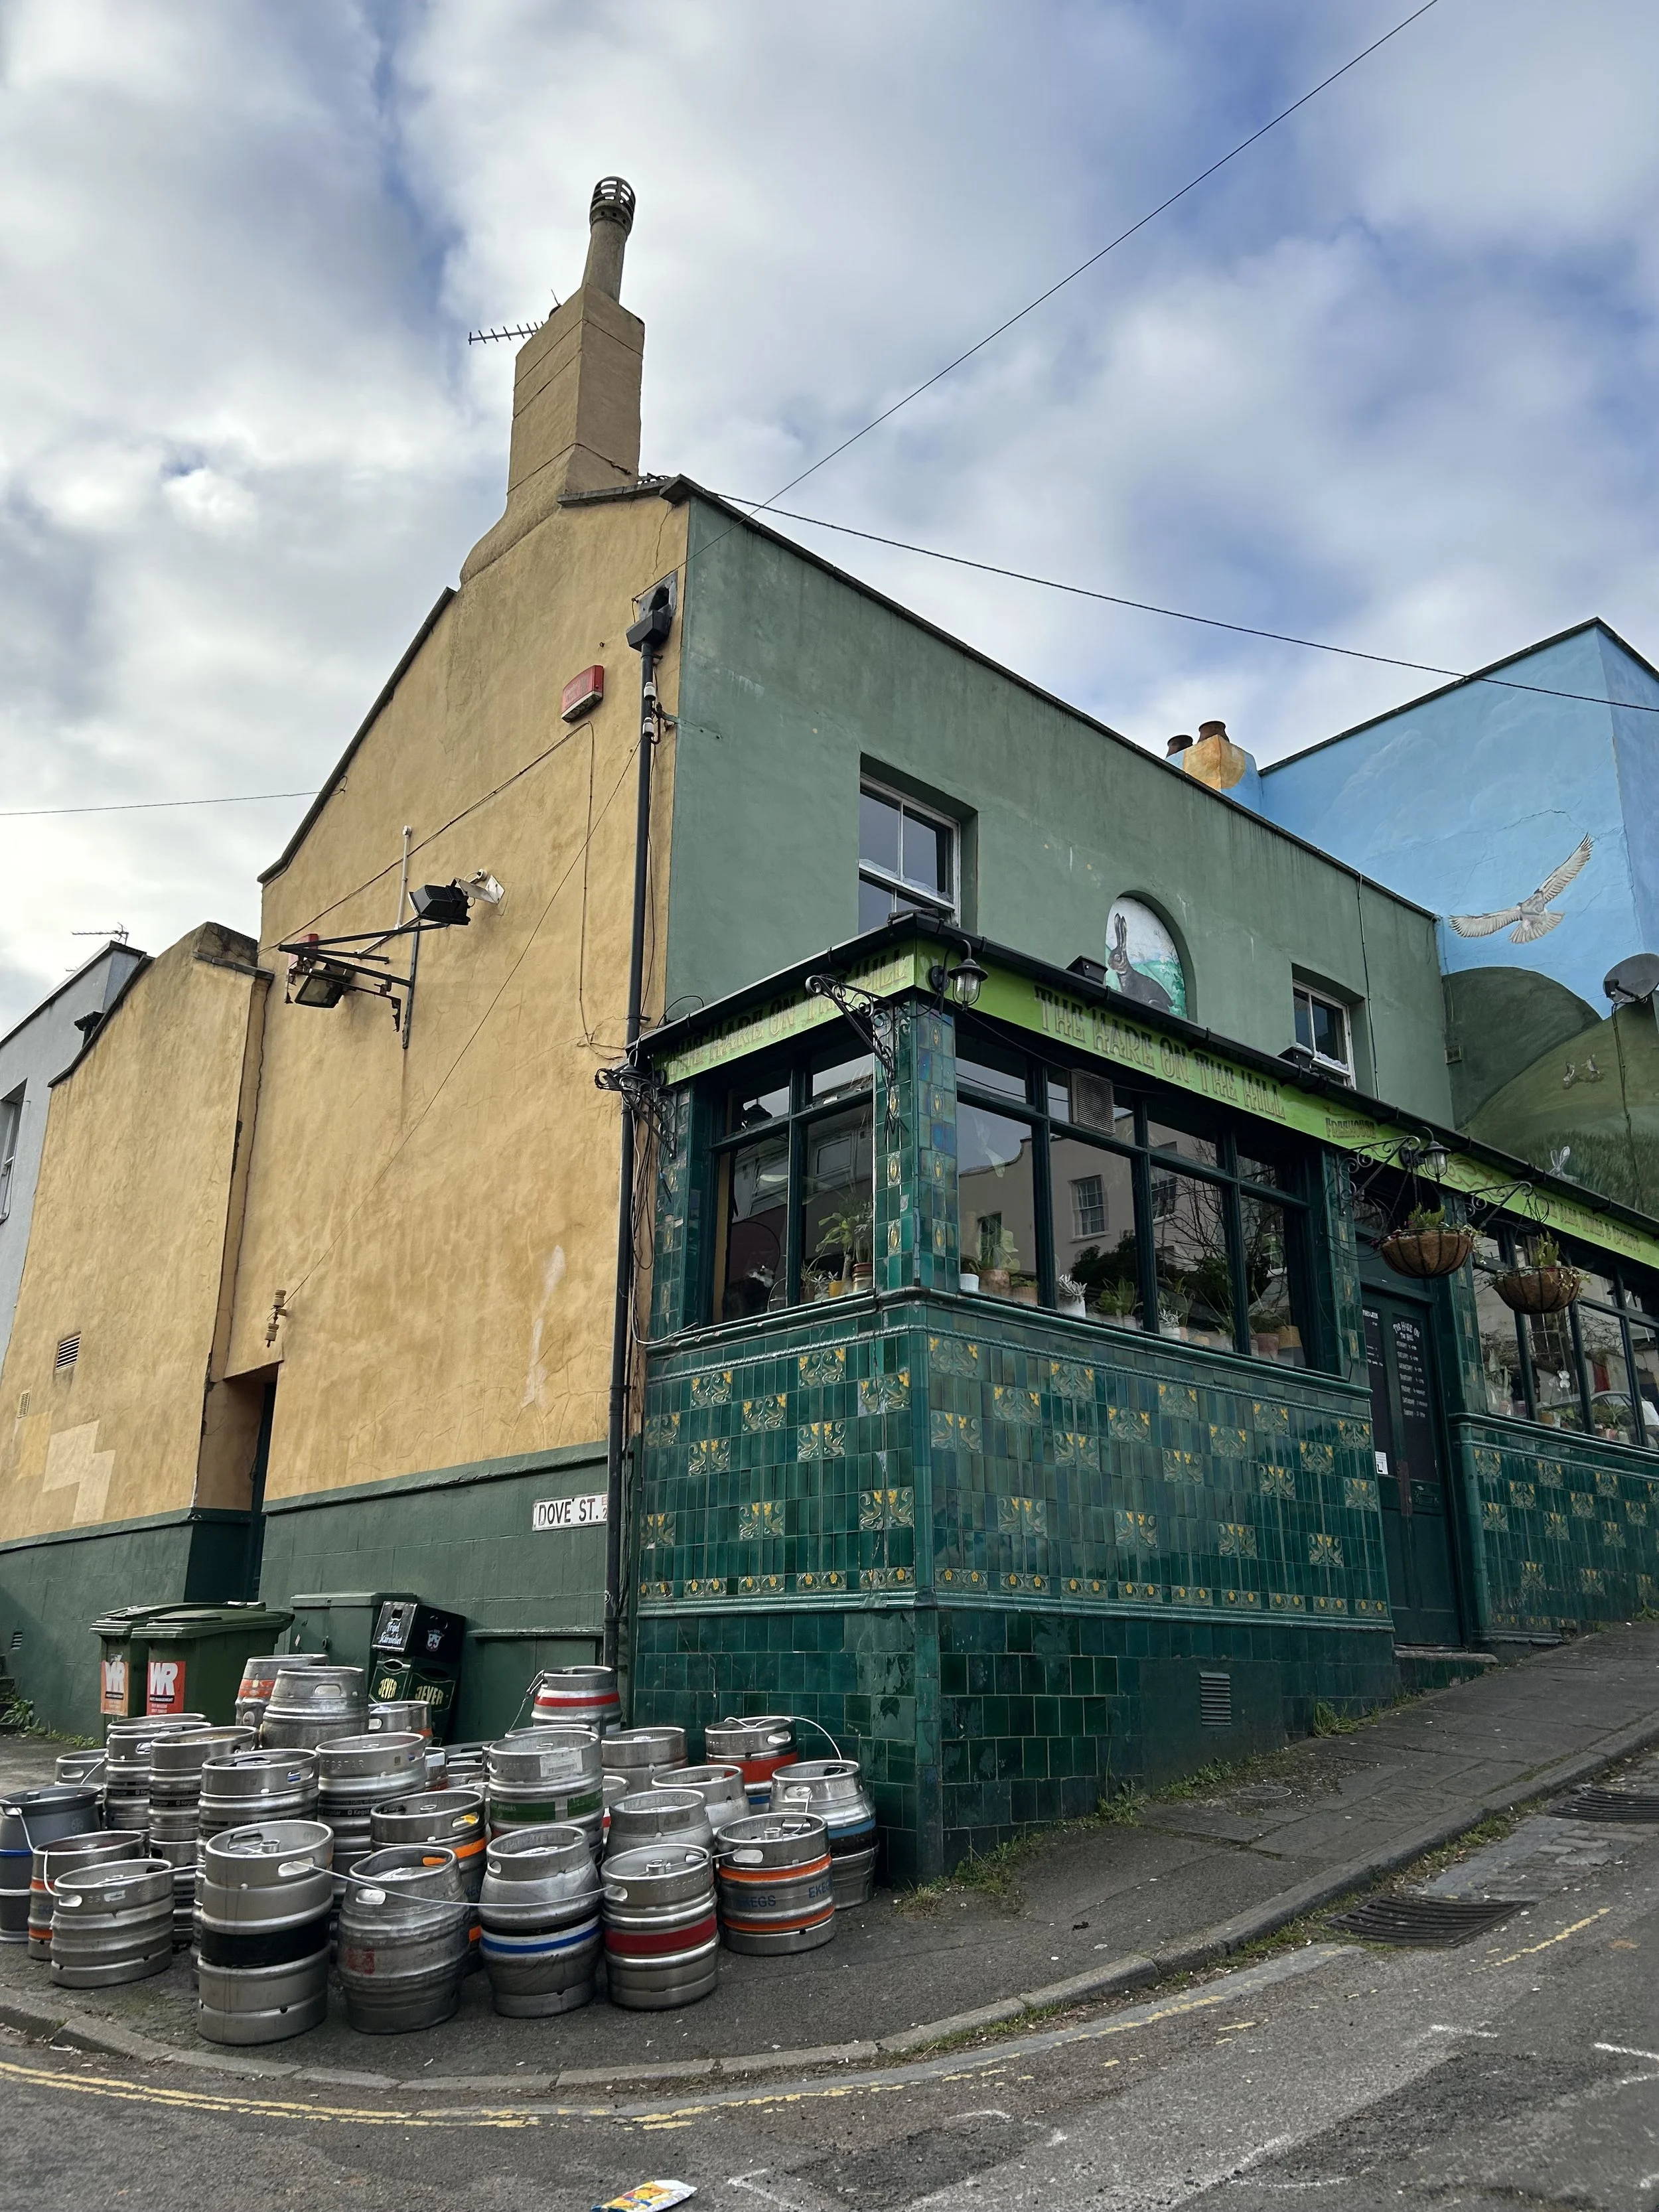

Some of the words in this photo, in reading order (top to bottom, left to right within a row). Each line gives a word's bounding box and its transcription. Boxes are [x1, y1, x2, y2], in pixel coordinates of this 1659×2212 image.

[709, 1009, 764, 1063] HARE
[769, 998, 795, 1036] ON
[856, 949, 907, 1001] HILL
[1035, 985, 1086, 1043] THE
[1092, 1009, 1155, 1070] HARE
[1160, 1037, 1189, 1083] ON
[1194, 1051, 1238, 1102] THE
[1241, 1069, 1286, 1120] HILL
[1325, 1118, 1376, 1139] FREEHOUSE
[538, 1501, 571, 1526] DOVE
[579, 1498, 599, 1522] ST.
[150, 1662, 179, 1695] WR
[378, 1678, 397, 1699] JEVER
[415, 1686, 444, 1705] JEVER
